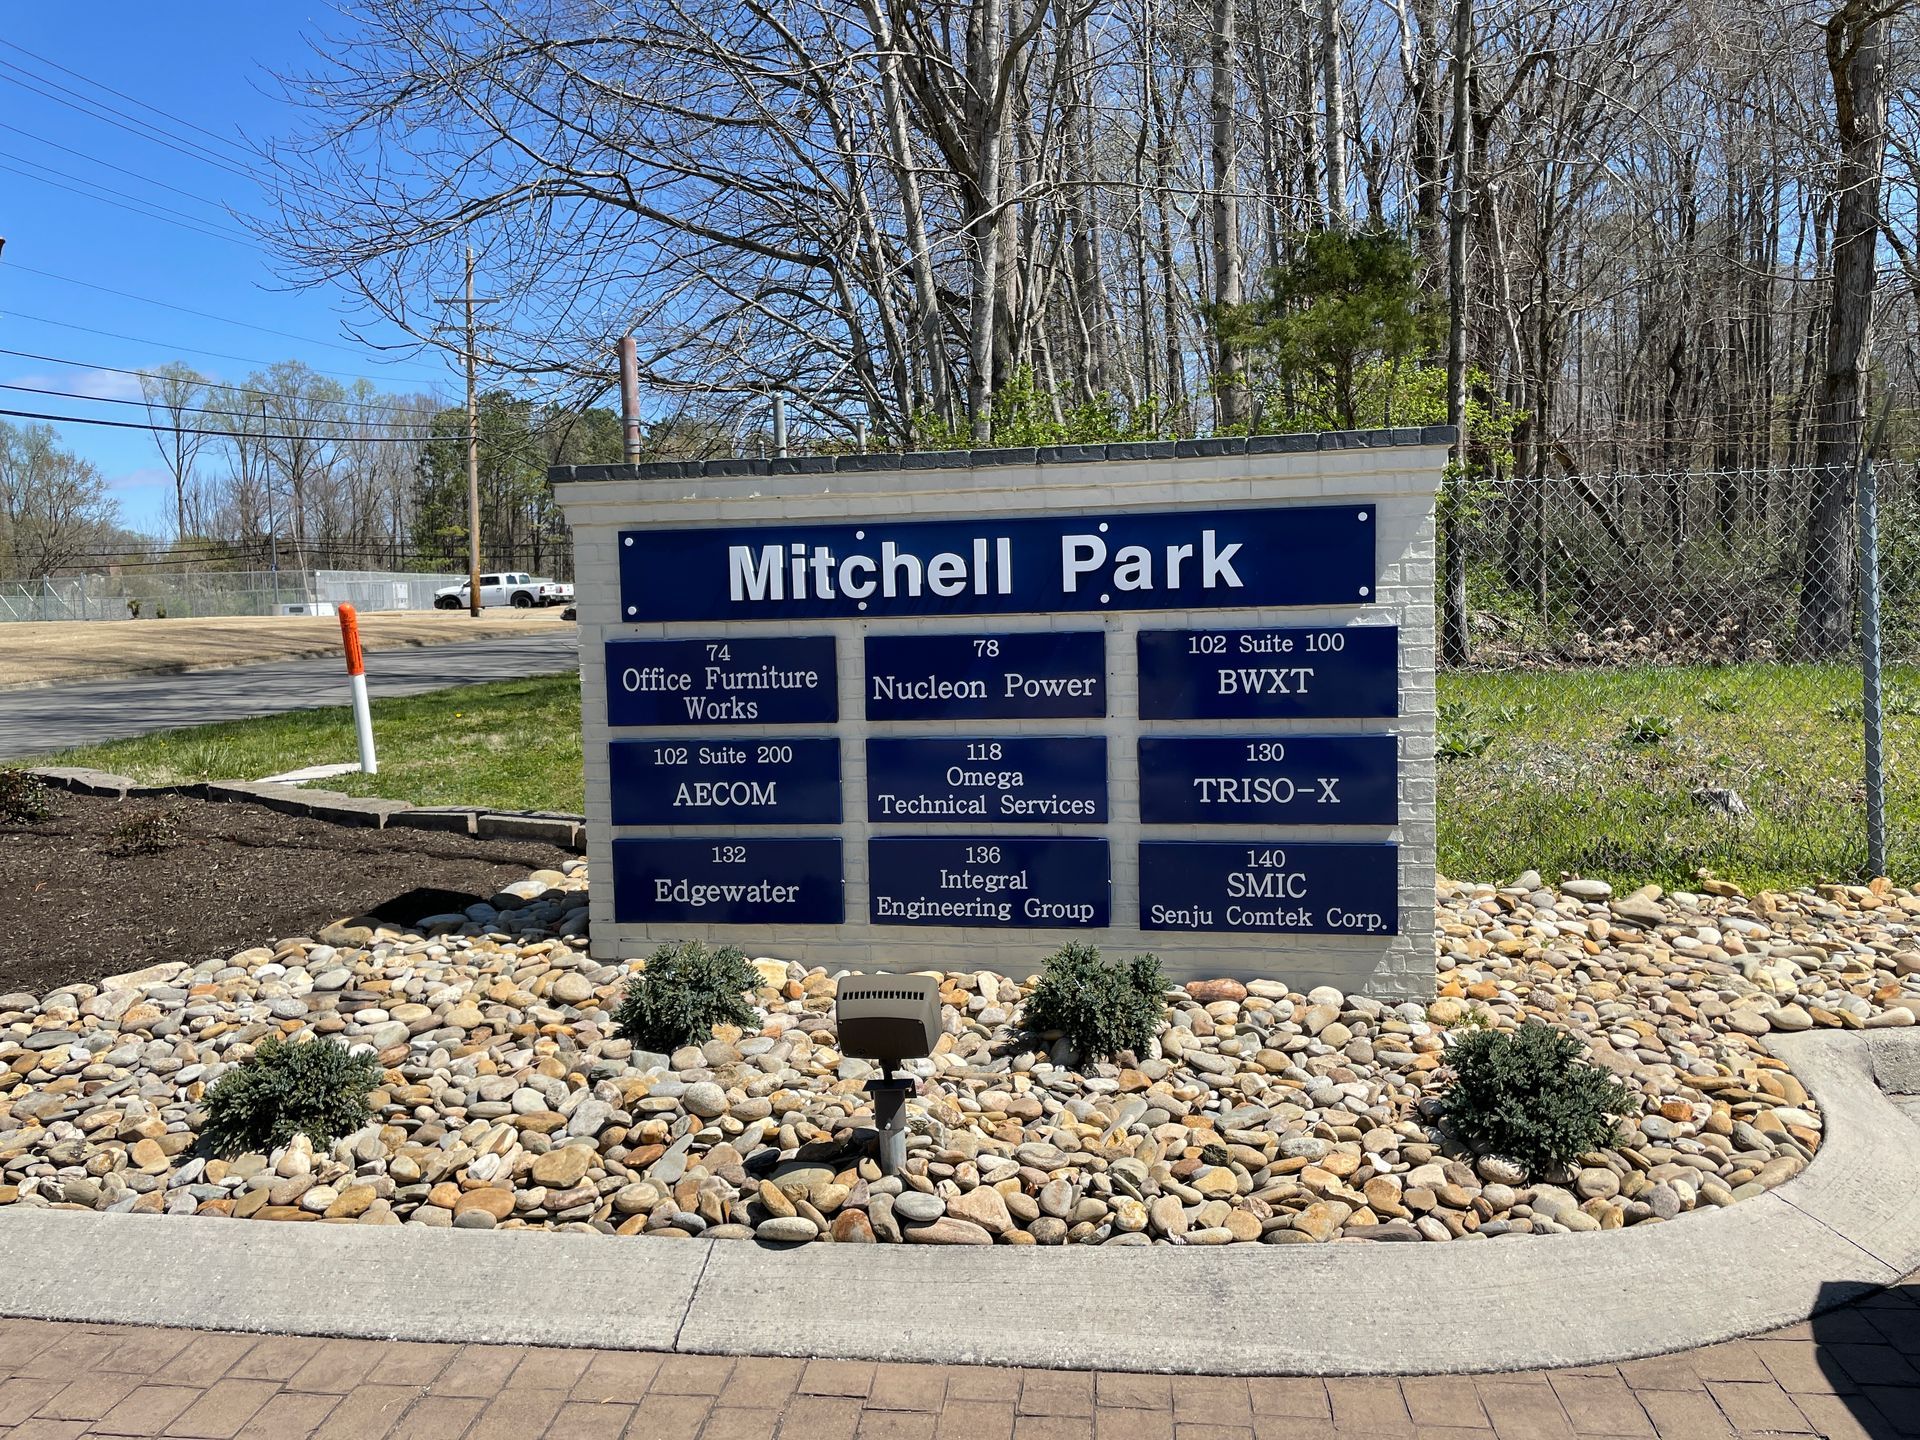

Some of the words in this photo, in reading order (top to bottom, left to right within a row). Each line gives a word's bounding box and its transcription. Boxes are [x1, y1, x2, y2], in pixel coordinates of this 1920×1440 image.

[729, 538, 1011, 600] Mitchell
[1062, 530, 1243, 592] Park
[707, 645, 730, 661] 74
[974, 640, 999, 657] 78
[1189, 636, 1226, 653] 102
[1240, 635, 1293, 652] Suite
[1306, 633, 1344, 651] 100
[623, 668, 691, 691] Office
[705, 666, 817, 689] Furniture
[873, 675, 987, 699] Nucleon
[1005, 674, 1096, 697] Power
[1219, 669, 1314, 694] BWXT
[684, 696, 757, 719] Works
[655, 748, 687, 764] 102
[699, 747, 746, 764] Suite
[758, 746, 792, 763] 200
[967, 743, 1002, 760] 118
[1247, 744, 1284, 761] 130
[947, 767, 1023, 789] Omega
[673, 782, 776, 806] AECOM
[1194, 778, 1340, 803] TRISO-X
[878, 795, 987, 814] Technical
[1001, 795, 1095, 814] Services
[713, 847, 745, 862] 132
[966, 847, 1000, 863] 136
[1248, 850, 1285, 867] 140
[941, 870, 1027, 892] Integral
[1227, 873, 1306, 898] SMIC
[655, 879, 799, 906] Edgewater
[877, 897, 1011, 920] Engineering
[1025, 898, 1094, 922] Group
[1151, 905, 1213, 927] Senju
[1227, 906, 1313, 926] Comtek
[1327, 908, 1387, 931] Corp.
